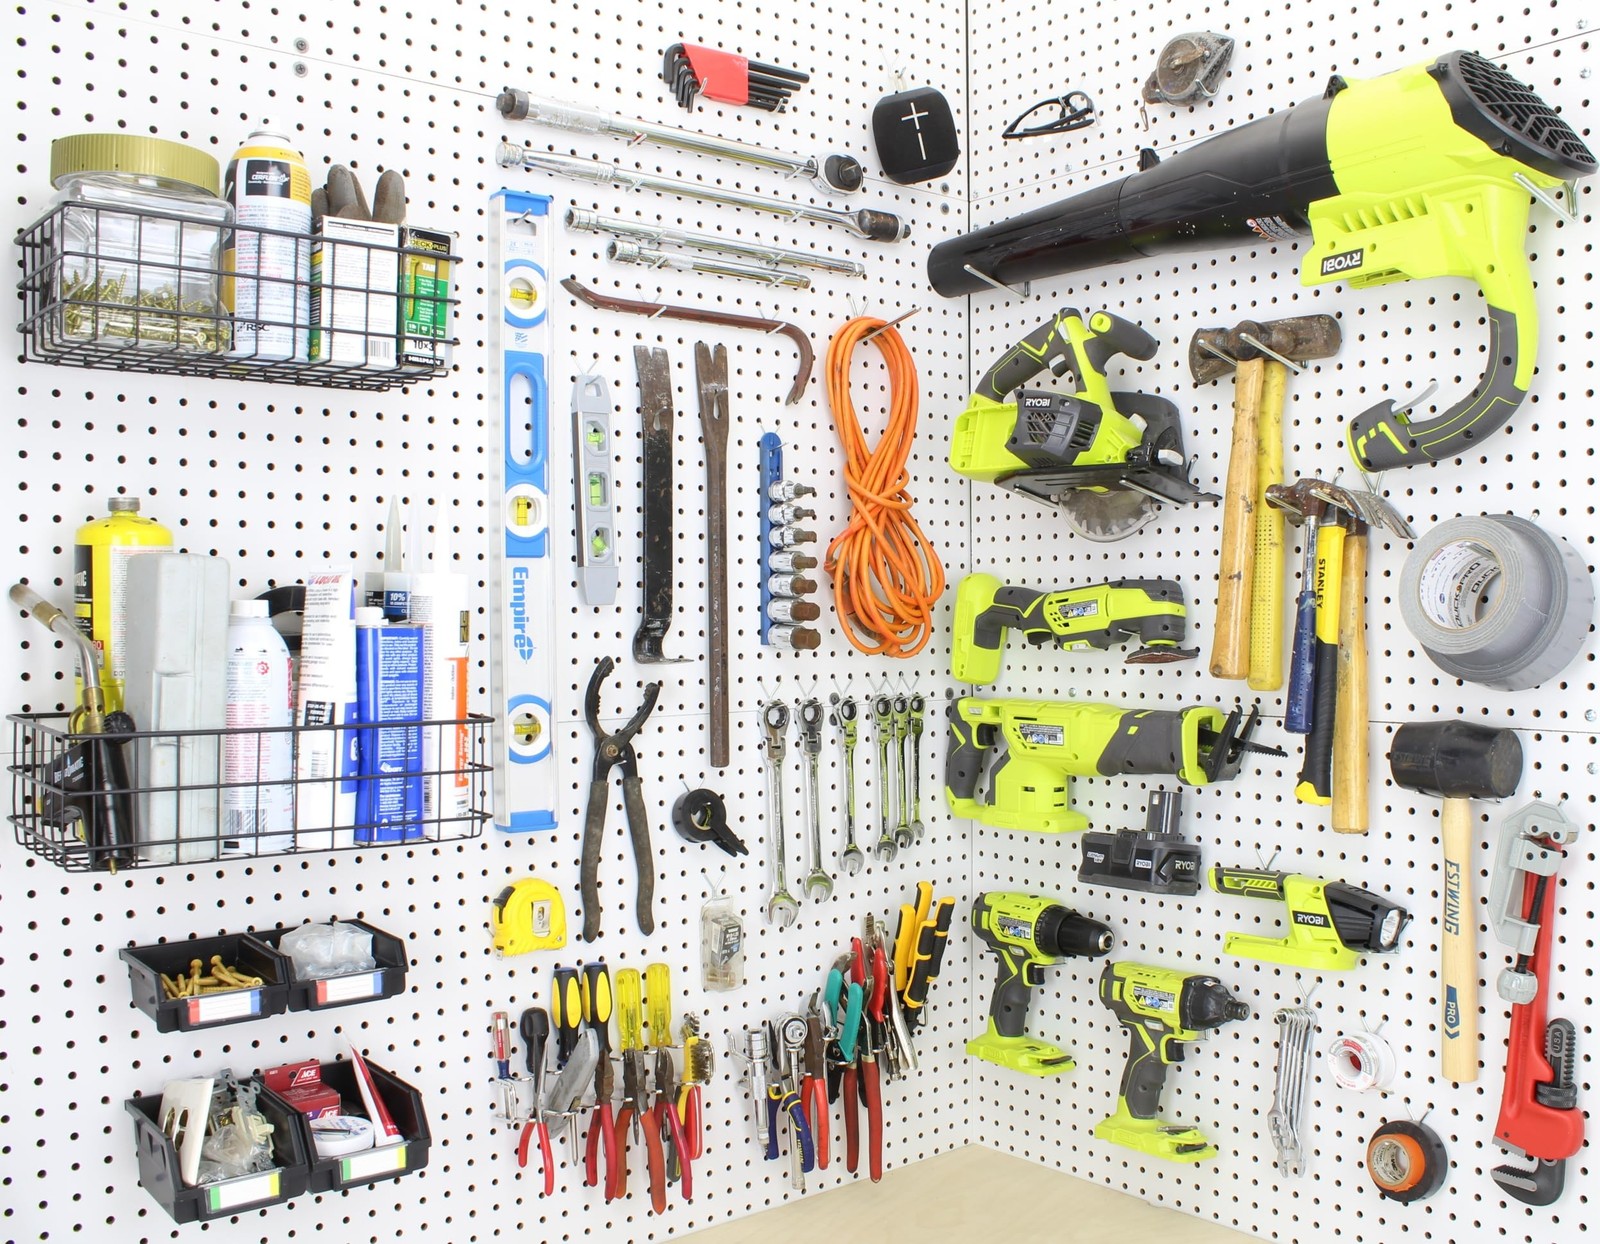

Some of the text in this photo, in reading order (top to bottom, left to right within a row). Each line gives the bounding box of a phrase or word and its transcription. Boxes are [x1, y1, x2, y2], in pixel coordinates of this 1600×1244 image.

[1323, 251, 1362, 273] RYOBI
[1025, 398, 1051, 407] RYOBI
[1317, 558, 1326, 609] STANLEY
[1460, 562, 1481, 586] PRO
[390, 592, 406, 602] 10%
[509, 566, 530, 649] Empire
[1445, 858, 1460, 936] ESTWING
[1296, 913, 1325, 926] RYOBI
[1447, 1001, 1456, 1024] PRO
[1553, 1031, 1562, 1051] USA
[301, 1069, 317, 1079] ACE
[324, 1109, 338, 1117] ACE
